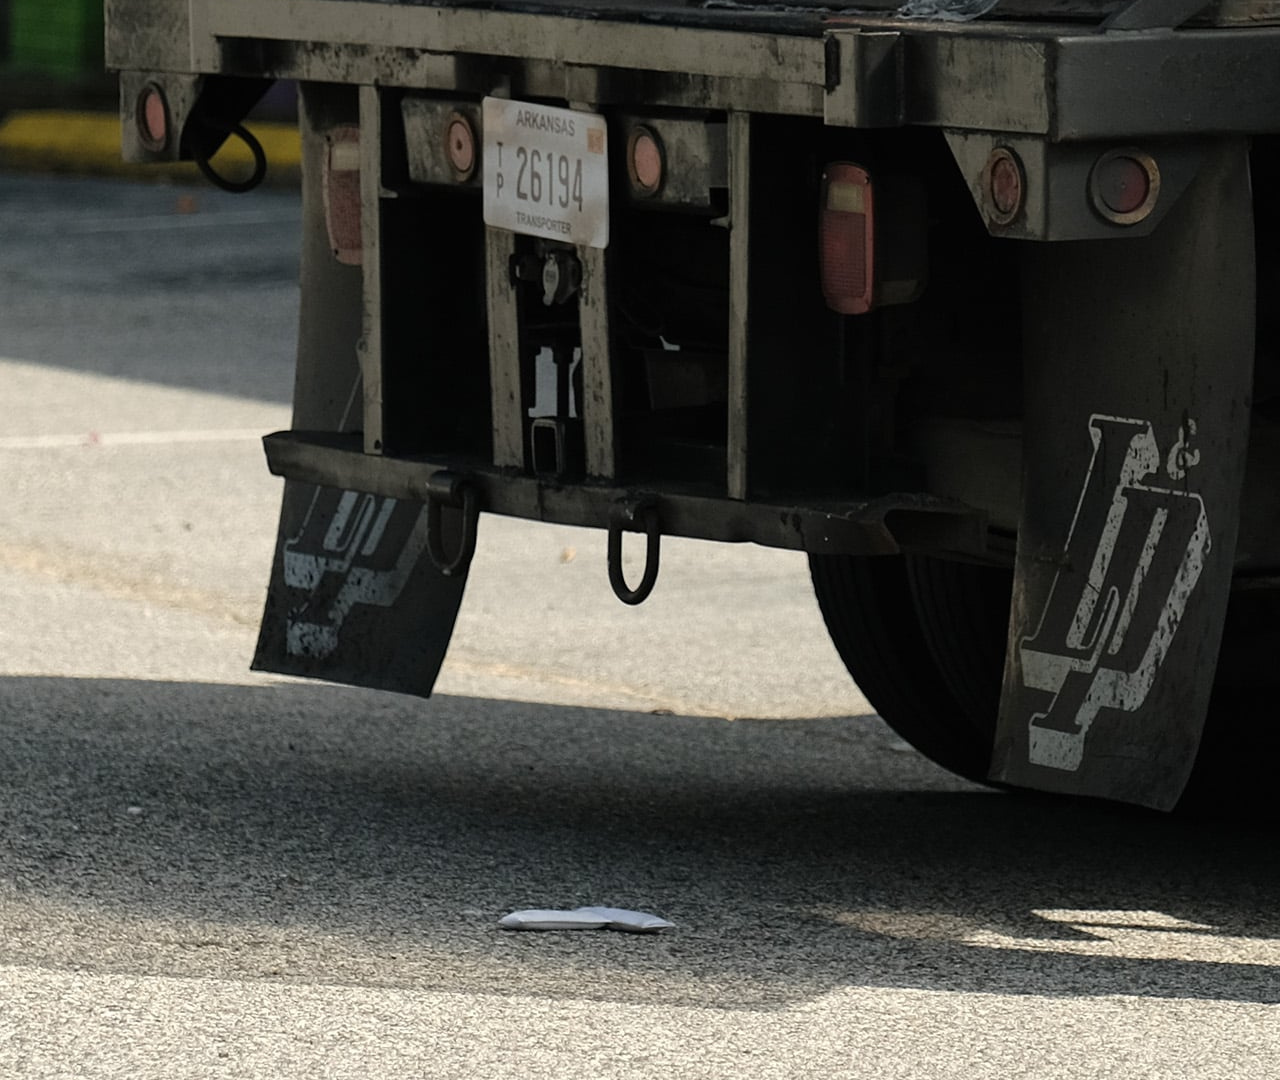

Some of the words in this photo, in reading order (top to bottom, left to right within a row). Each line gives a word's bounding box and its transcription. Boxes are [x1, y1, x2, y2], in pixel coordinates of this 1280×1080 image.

[515, 109, 576, 137] ARKANSAS
[516, 145, 583, 213] 26194
[515, 211, 572, 235] TRANSPORTER
